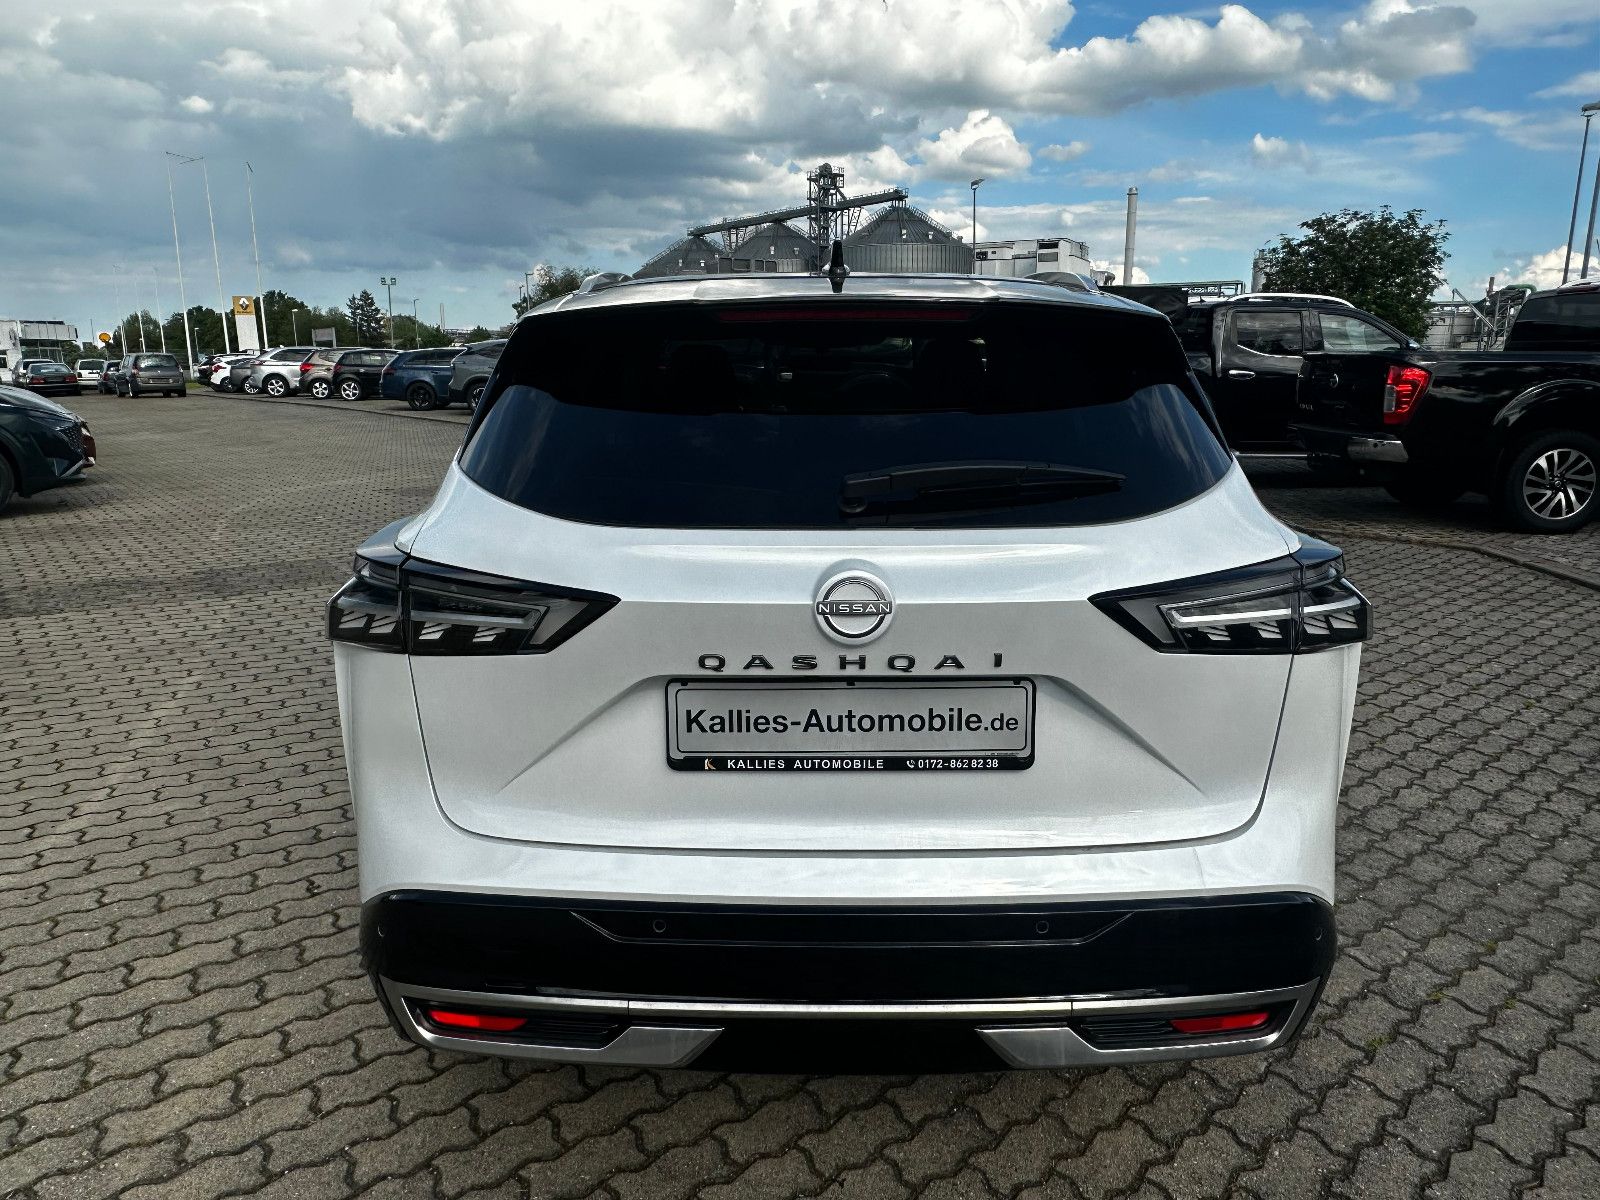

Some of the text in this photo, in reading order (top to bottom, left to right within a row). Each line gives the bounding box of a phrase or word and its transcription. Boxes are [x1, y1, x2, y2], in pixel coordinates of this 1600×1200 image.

[818, 602, 892, 614] NISSAN
[698, 652, 1004, 673] QASHQAI
[685, 707, 1020, 733] Kallies-Automobile.de
[727, 759, 786, 769] KALLIES
[793, 759, 885, 769] AUTOMOBILE
[918, 758, 969, 769] 0172-862
[971, 758, 984, 768] 82
[986, 758, 999, 768] 38
